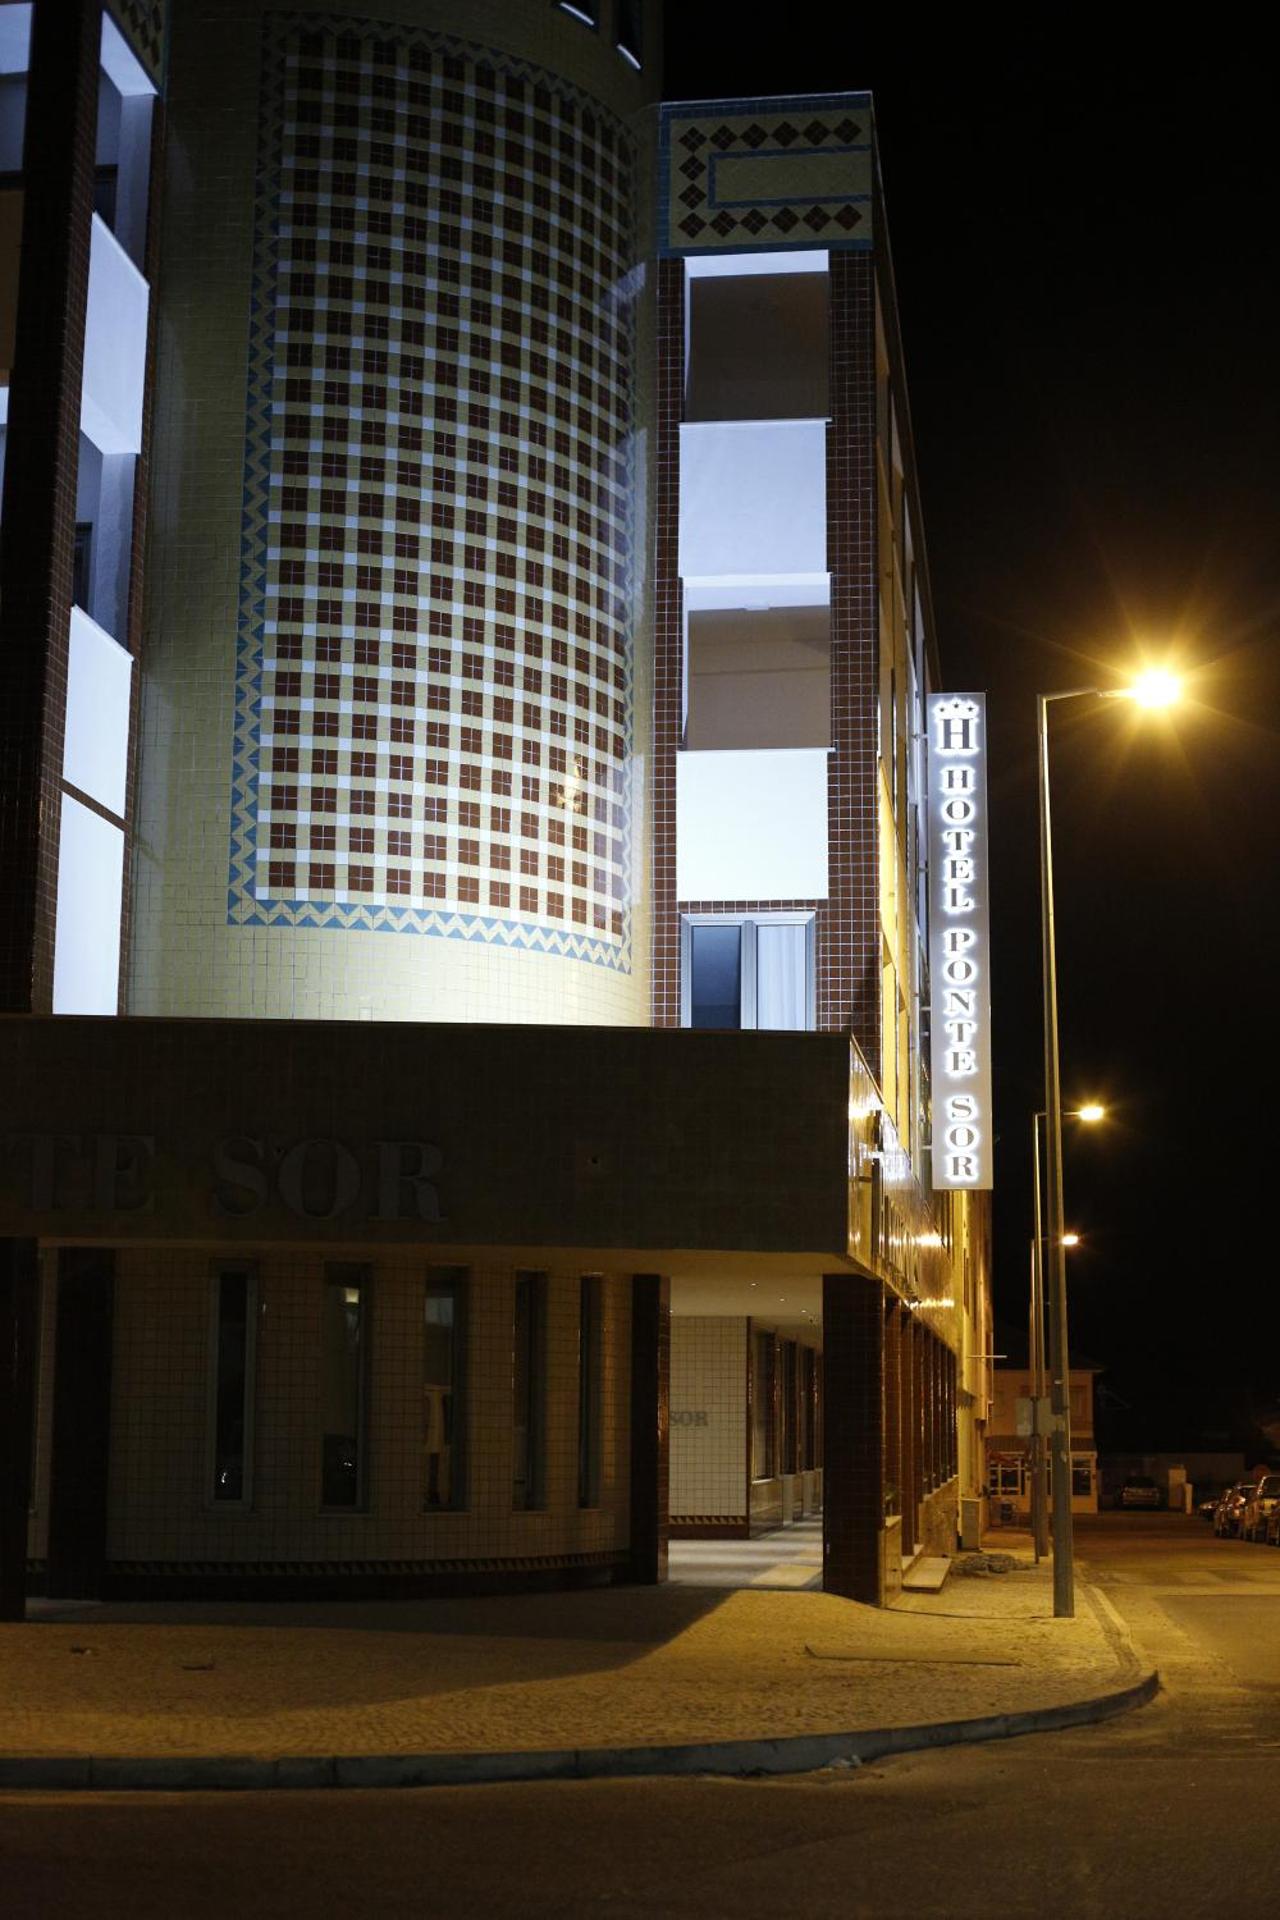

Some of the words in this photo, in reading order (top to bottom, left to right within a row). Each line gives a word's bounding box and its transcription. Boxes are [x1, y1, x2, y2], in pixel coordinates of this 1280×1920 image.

[940, 717, 974, 750] H
[945, 769, 971, 908] HOTEL
[947, 931, 973, 1072] PONTE
[212, 1135, 449, 1223] SOR
[950, 1097, 975, 1177] SOR
